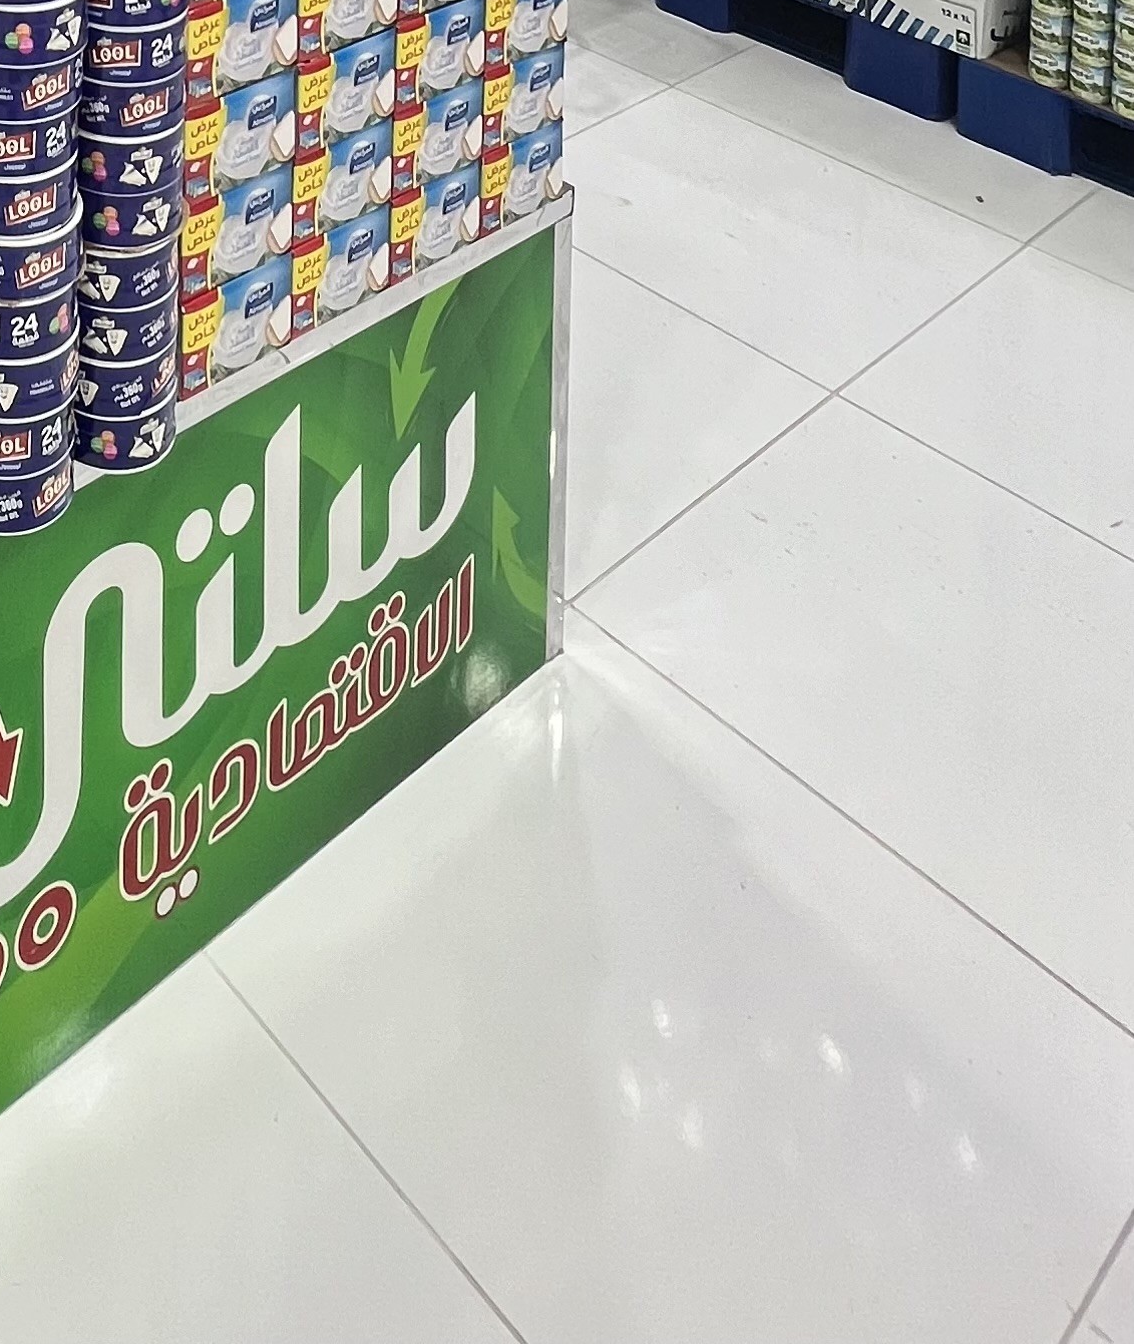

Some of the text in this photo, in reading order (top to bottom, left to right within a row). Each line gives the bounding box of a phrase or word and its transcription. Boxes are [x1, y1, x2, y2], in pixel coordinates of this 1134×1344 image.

[93, 46, 135, 60] LOOL
[187, 310, 215, 331] عرض
[187, 327, 216, 347] خاص
[119, 554, 475, 918] الاقتصادية
